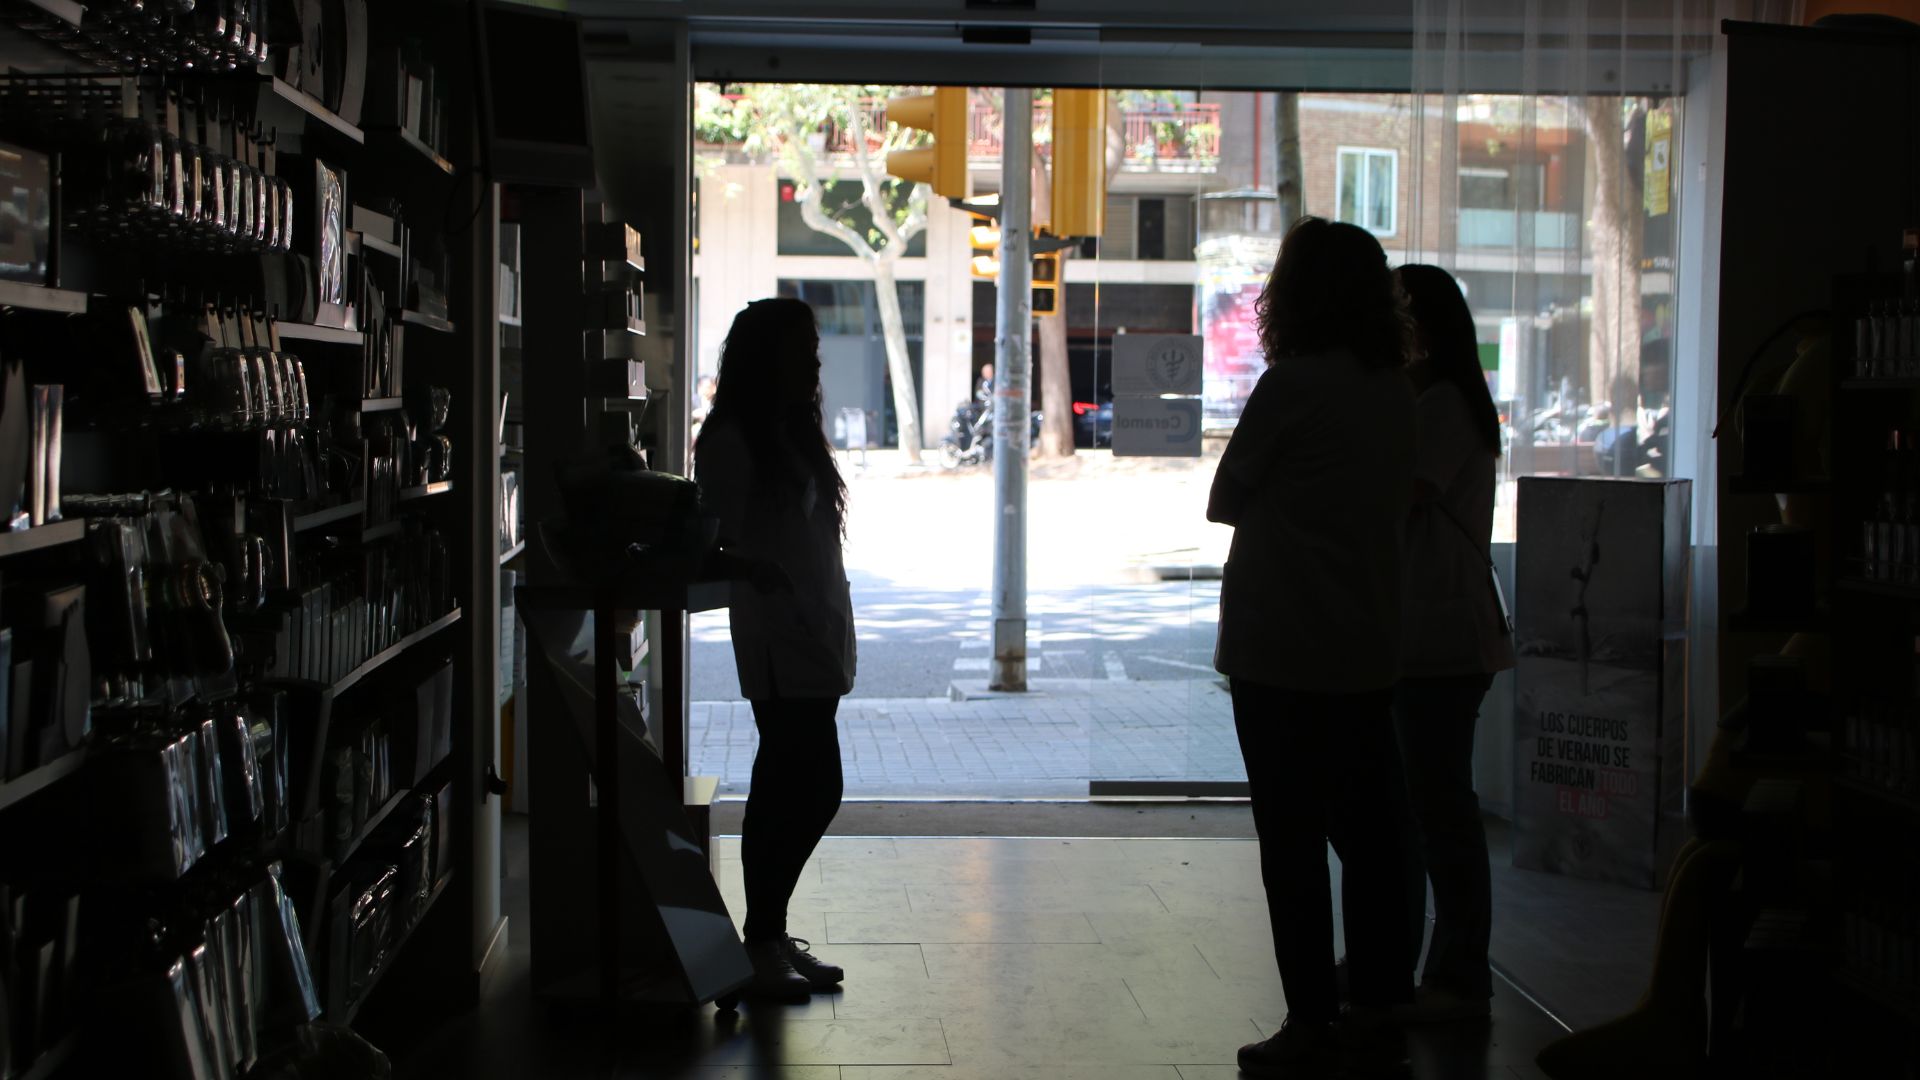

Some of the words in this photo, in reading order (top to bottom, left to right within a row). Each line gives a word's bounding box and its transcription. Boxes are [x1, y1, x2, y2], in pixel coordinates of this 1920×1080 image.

[1541, 712, 1564, 732] LOS
[1568, 714, 1628, 741] CUERPOS
[1538, 737, 1553, 757] DE
[1557, 739, 1610, 765] VERANO
[1614, 746, 1630, 767] SE
[1531, 761, 1594, 789] FABRICAN
[1601, 771, 1637, 794] TODO
[1560, 791, 1575, 812] EL
[1578, 791, 1605, 816] AÑO
